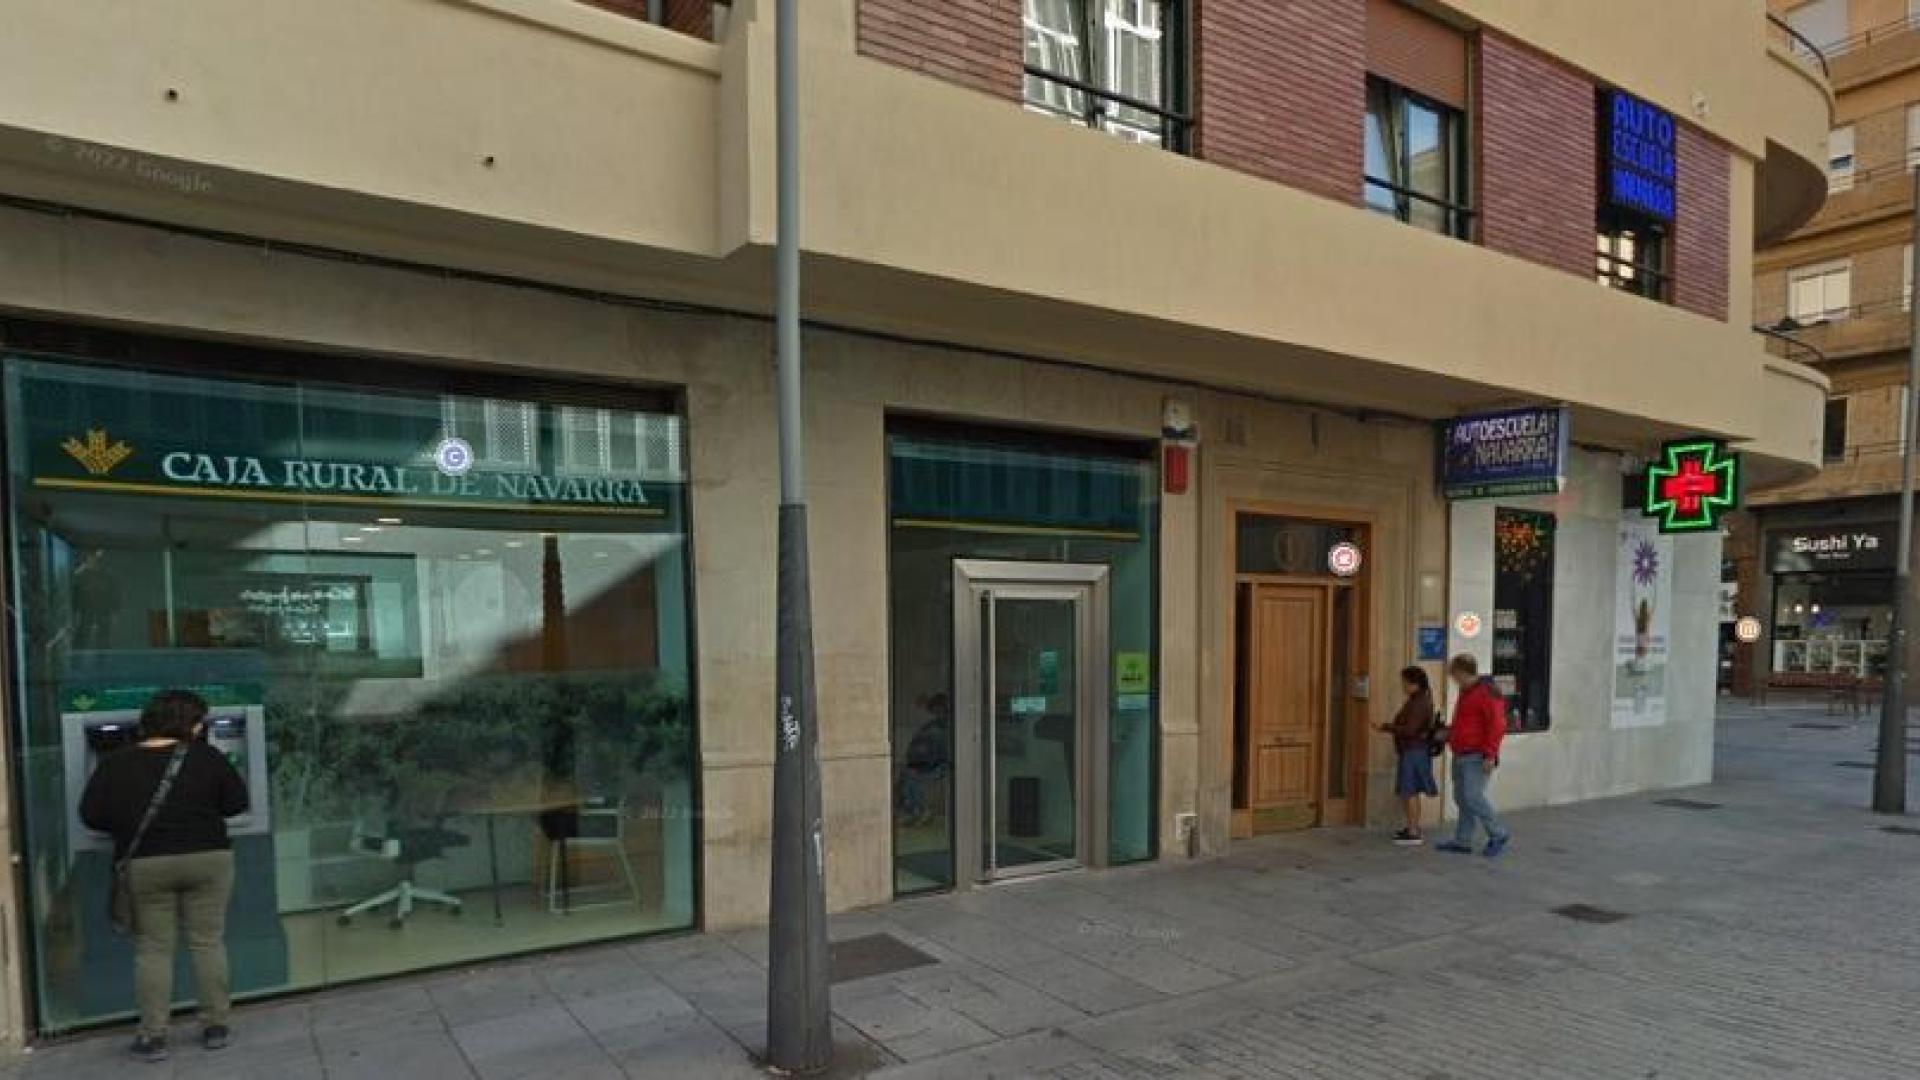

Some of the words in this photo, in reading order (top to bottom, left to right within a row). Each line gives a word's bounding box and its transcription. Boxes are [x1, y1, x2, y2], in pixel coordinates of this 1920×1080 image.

[1613, 93, 1674, 148] AUTO
[1454, 412, 1548, 445] AUTOESCUELA
[162, 451, 271, 486] CAJA
[283, 460, 418, 494] RURAL
[432, 470, 482, 497] DE
[497, 474, 648, 504] NAVARRA
[1793, 534, 1848, 553] Sushi
[1852, 533, 1880, 551] Ya
